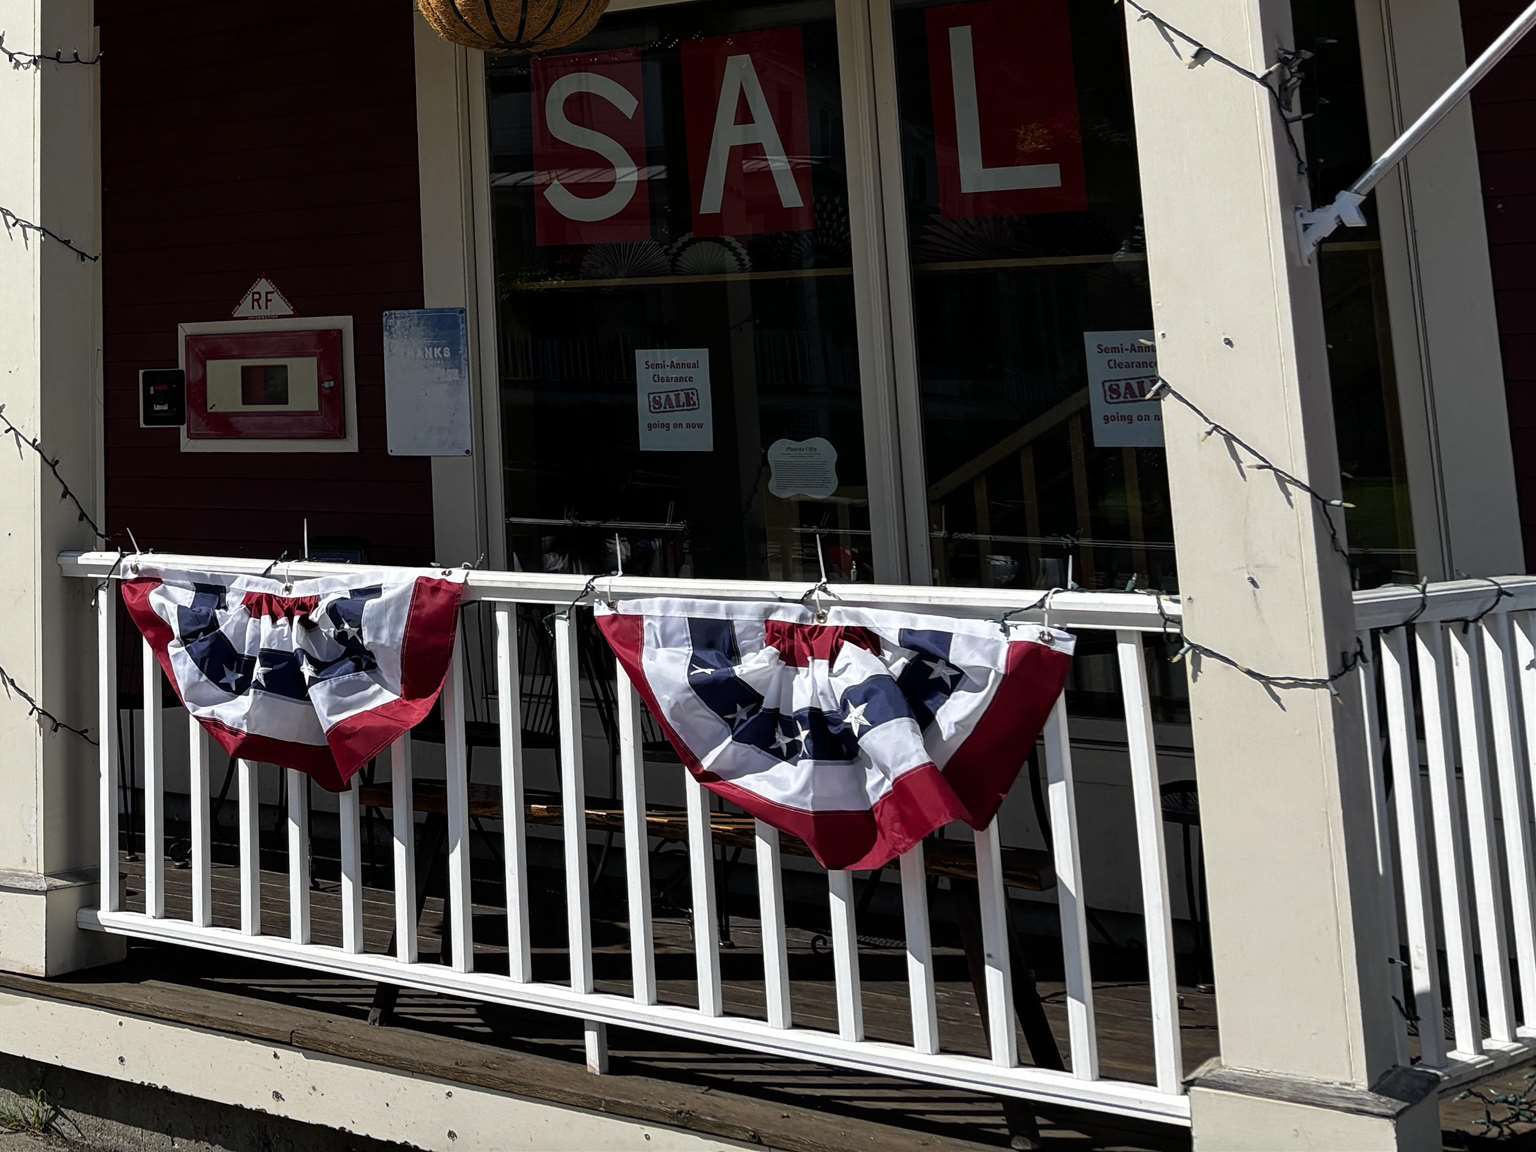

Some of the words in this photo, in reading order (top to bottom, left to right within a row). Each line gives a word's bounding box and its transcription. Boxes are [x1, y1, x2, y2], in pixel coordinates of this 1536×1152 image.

[543, 25, 1061, 223] SAL
[251, 291, 275, 310] RF
[644, 360, 699, 370] Semi-Annual
[652, 374, 694, 383] Clearance
[651, 391, 697, 410] SALE
[1103, 412, 1133, 425] going
[1137, 414, 1150, 422] on
[647, 421, 671, 432] going
[686, 422, 704, 430] now
